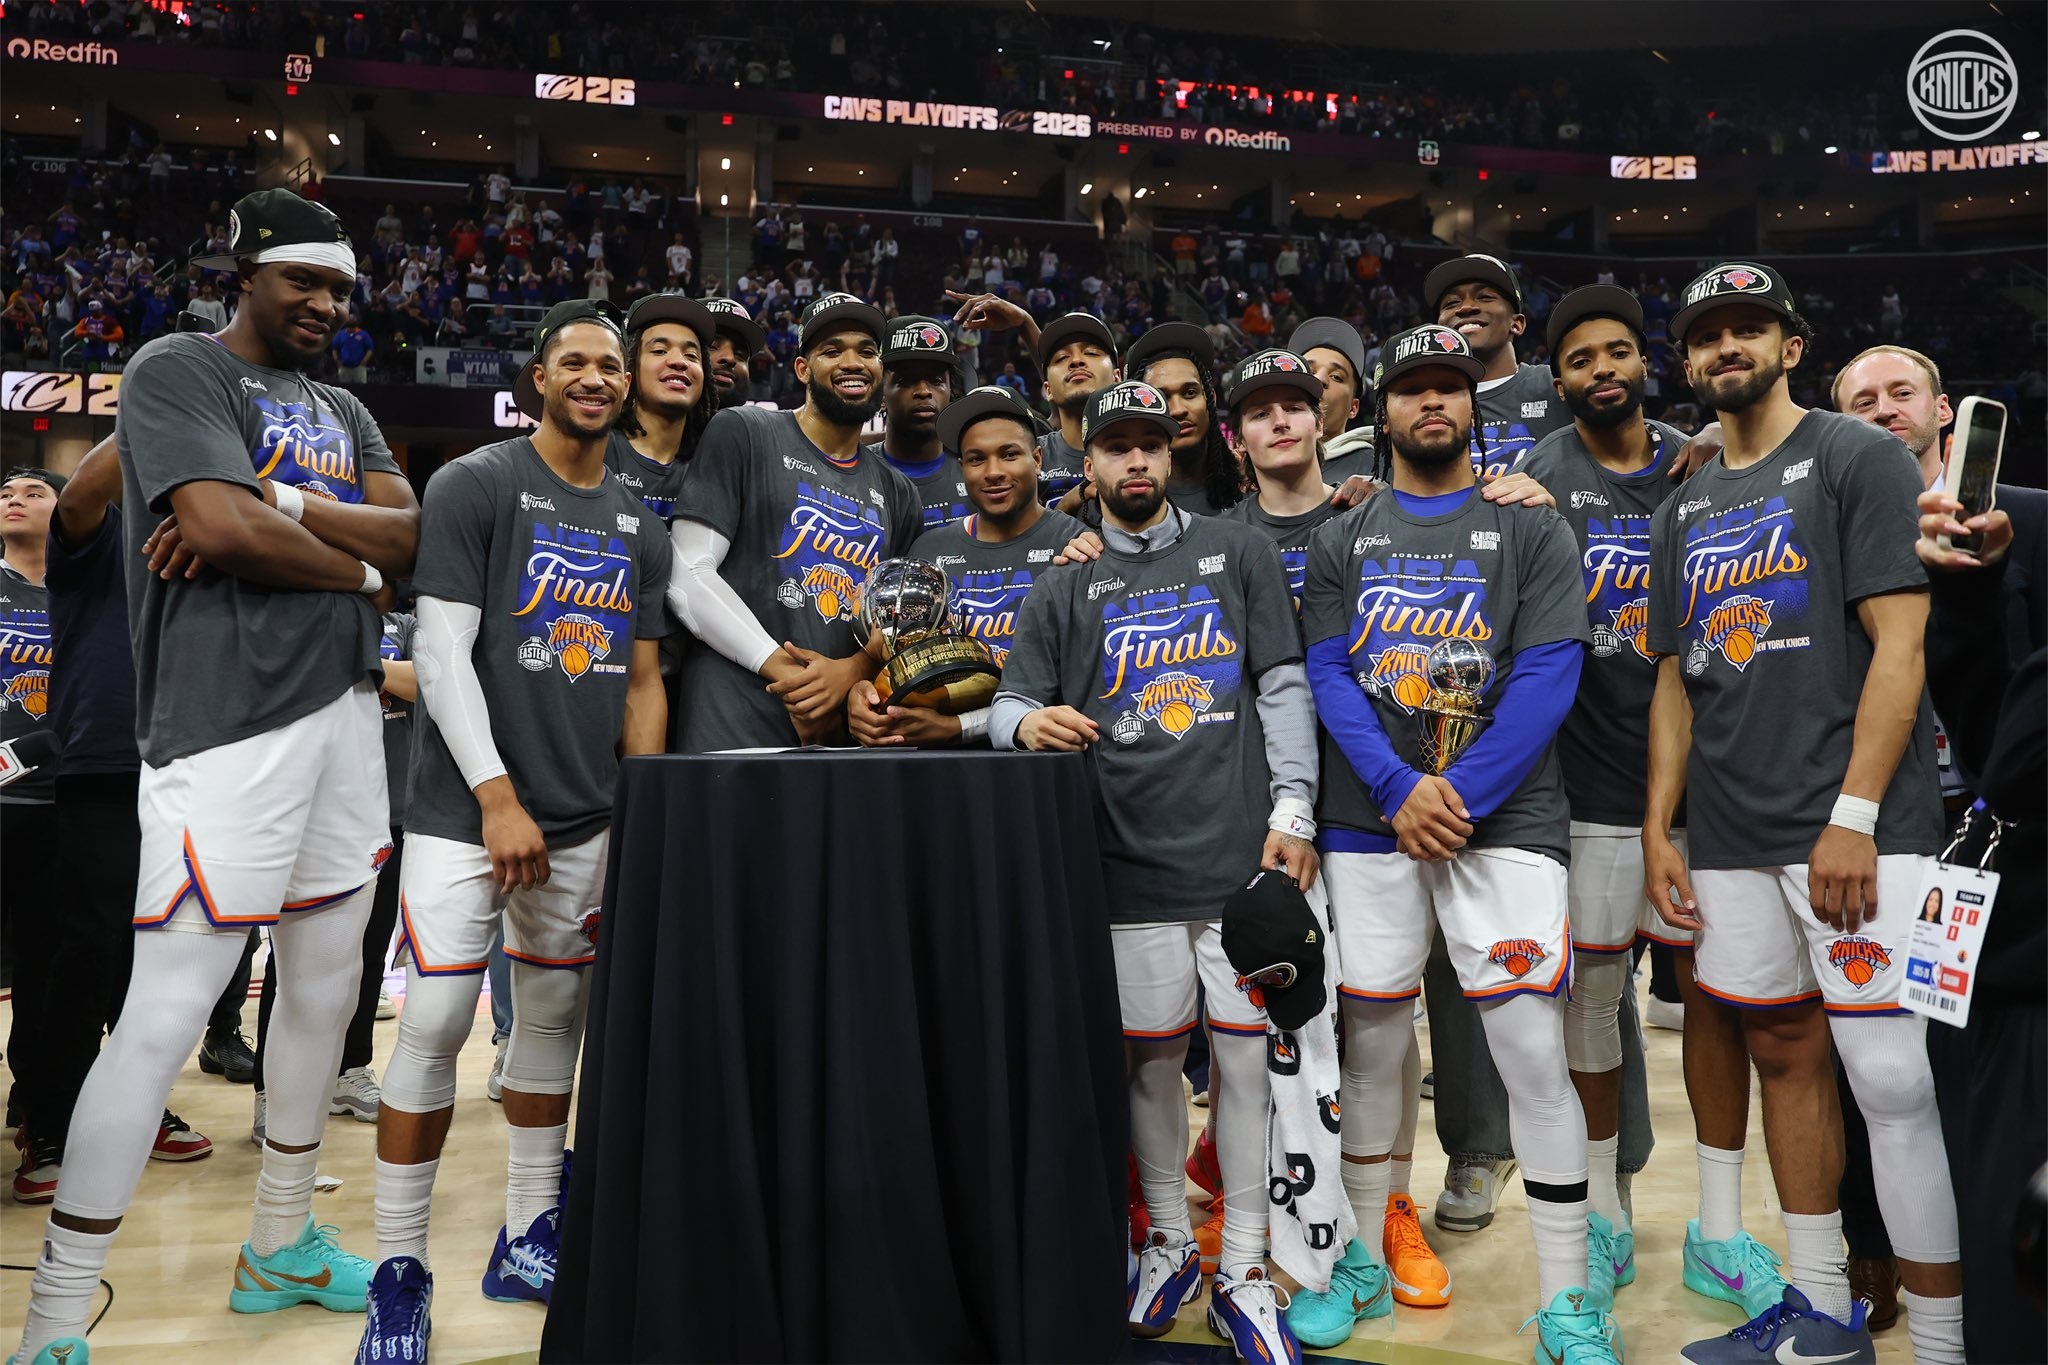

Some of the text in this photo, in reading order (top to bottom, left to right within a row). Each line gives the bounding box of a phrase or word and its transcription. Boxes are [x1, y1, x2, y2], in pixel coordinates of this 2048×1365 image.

[33, 39, 118, 65] Redfin
[824, 95, 1091, 138] CAVS PLAYOFFS 2026
[1097, 121, 1291, 152] PRESENTED BY Redfin
[1931, 139, 2048, 173] PLAYOFFS
[891, 332, 919, 350] FINALS
[1395, 336, 1431, 363] FINALS
[463, 360, 500, 375] WTAM
[1098, 392, 1132, 417] FINALS
[789, 457, 818, 475] Finals
[528, 493, 556, 511] Finals
[1578, 490, 1609, 509] Finals
[533, 539, 560, 549] EASTERN
[561, 543, 599, 556] CONFERENCE
[771, 505, 880, 571] Finals
[510, 551, 632, 616] Finals
[804, 566, 853, 604] KNICKS
[1092, 576, 1126, 600] Finals
[1392, 573, 1441, 582] CONFERENCE
[1443, 576, 1487, 584] CHAMPIONS
[1676, 524, 1808, 628] Finals
[1179, 598, 1220, 610] CHAMPIONS
[1349, 586, 1492, 655] Finals
[1616, 605, 1648, 632] KNI
[1706, 599, 1771, 642] KNICKS
[551, 620, 609, 652] KNICKS
[1767, 639, 1786, 651] YORK
[1786, 636, 1810, 649] KNICKS
[520, 647, 551, 663] EASTERN
[929, 650, 967, 664] CONFERENCE
[1098, 612, 1237, 699] Finals
[1140, 677, 1211, 713] KNICKS
[1114, 719, 1142, 734] EASTERN
[1488, 939, 1546, 961] KNICKS
[1829, 940, 1891, 965] KNICKS
